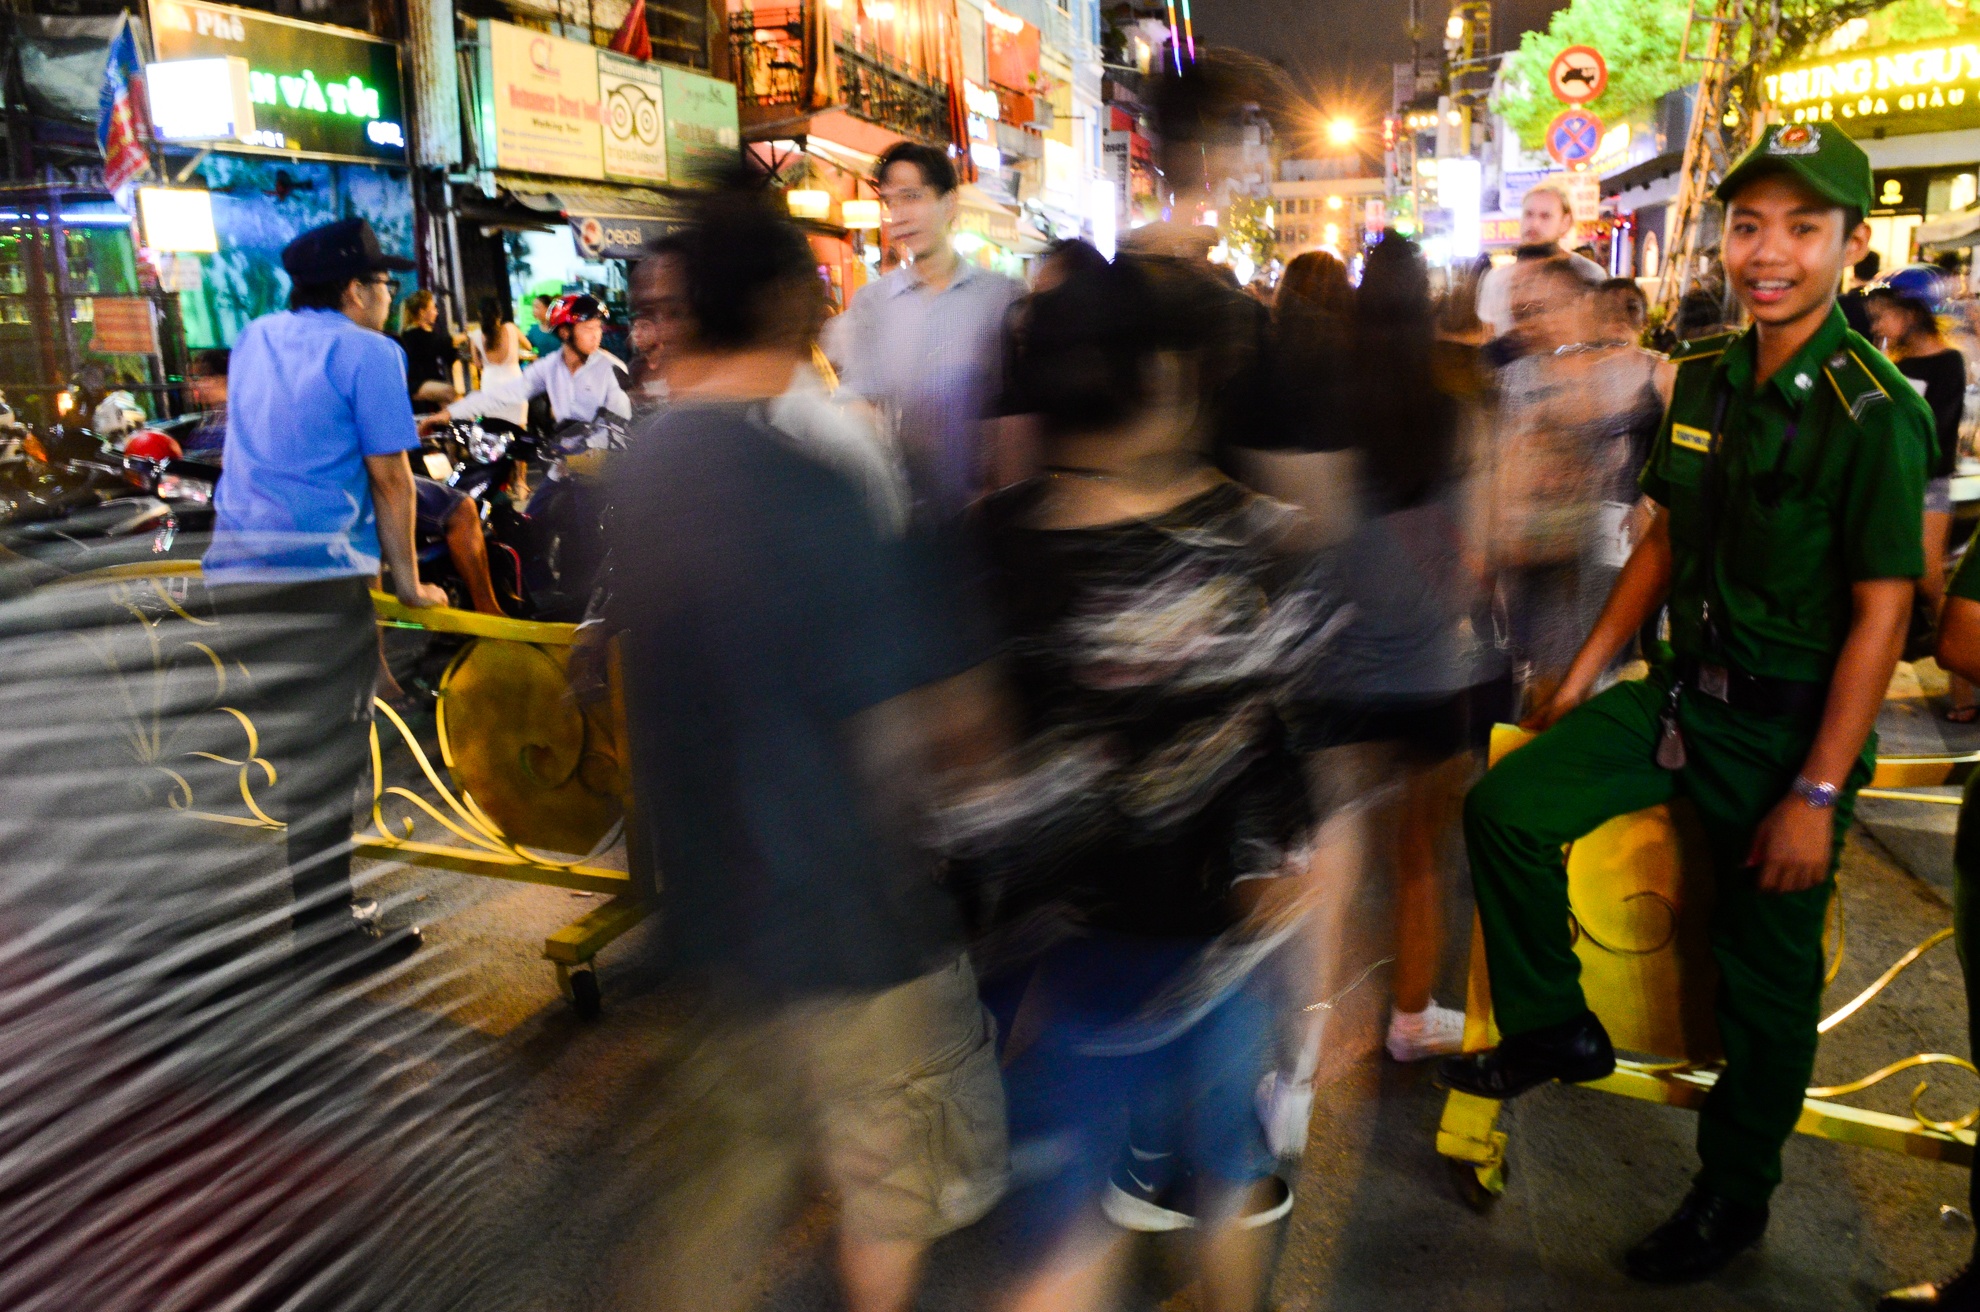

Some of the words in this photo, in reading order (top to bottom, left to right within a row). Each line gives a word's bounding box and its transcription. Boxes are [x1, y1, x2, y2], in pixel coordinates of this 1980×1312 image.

[279, 69, 328, 112] VÀ
[1765, 59, 1873, 104] TRUNG
[1841, 94, 1889, 119] CỦA
[604, 226, 642, 249] pepsi
